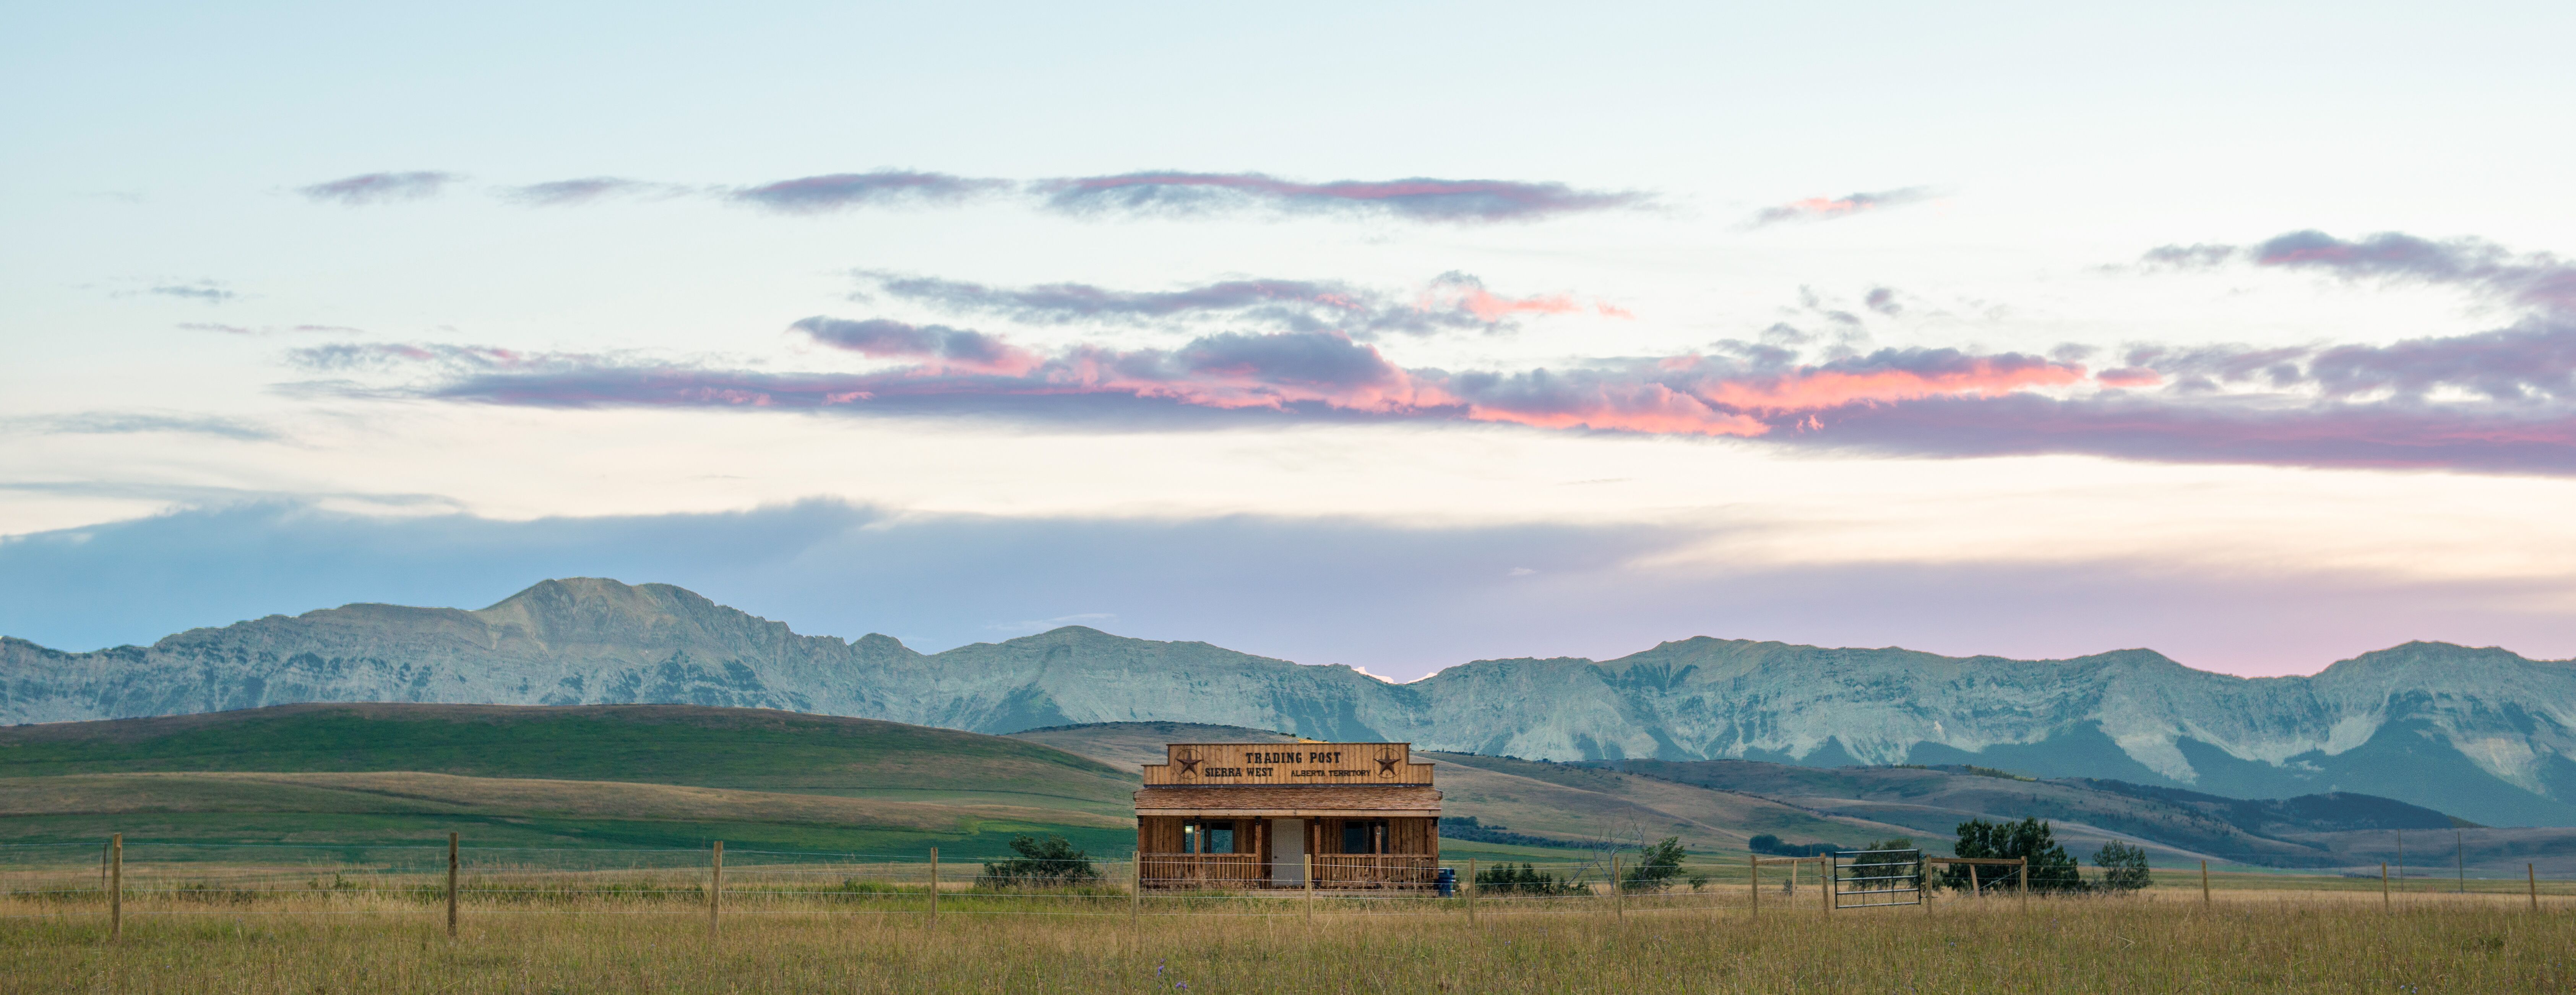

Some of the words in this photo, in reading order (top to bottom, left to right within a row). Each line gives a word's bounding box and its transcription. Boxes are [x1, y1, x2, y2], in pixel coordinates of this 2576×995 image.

[1246, 752, 1302, 763] TRADING
[1310, 752, 1341, 763] POST
[1205, 767, 1242, 777] SIERRA
[1247, 767, 1273, 776] WEST
